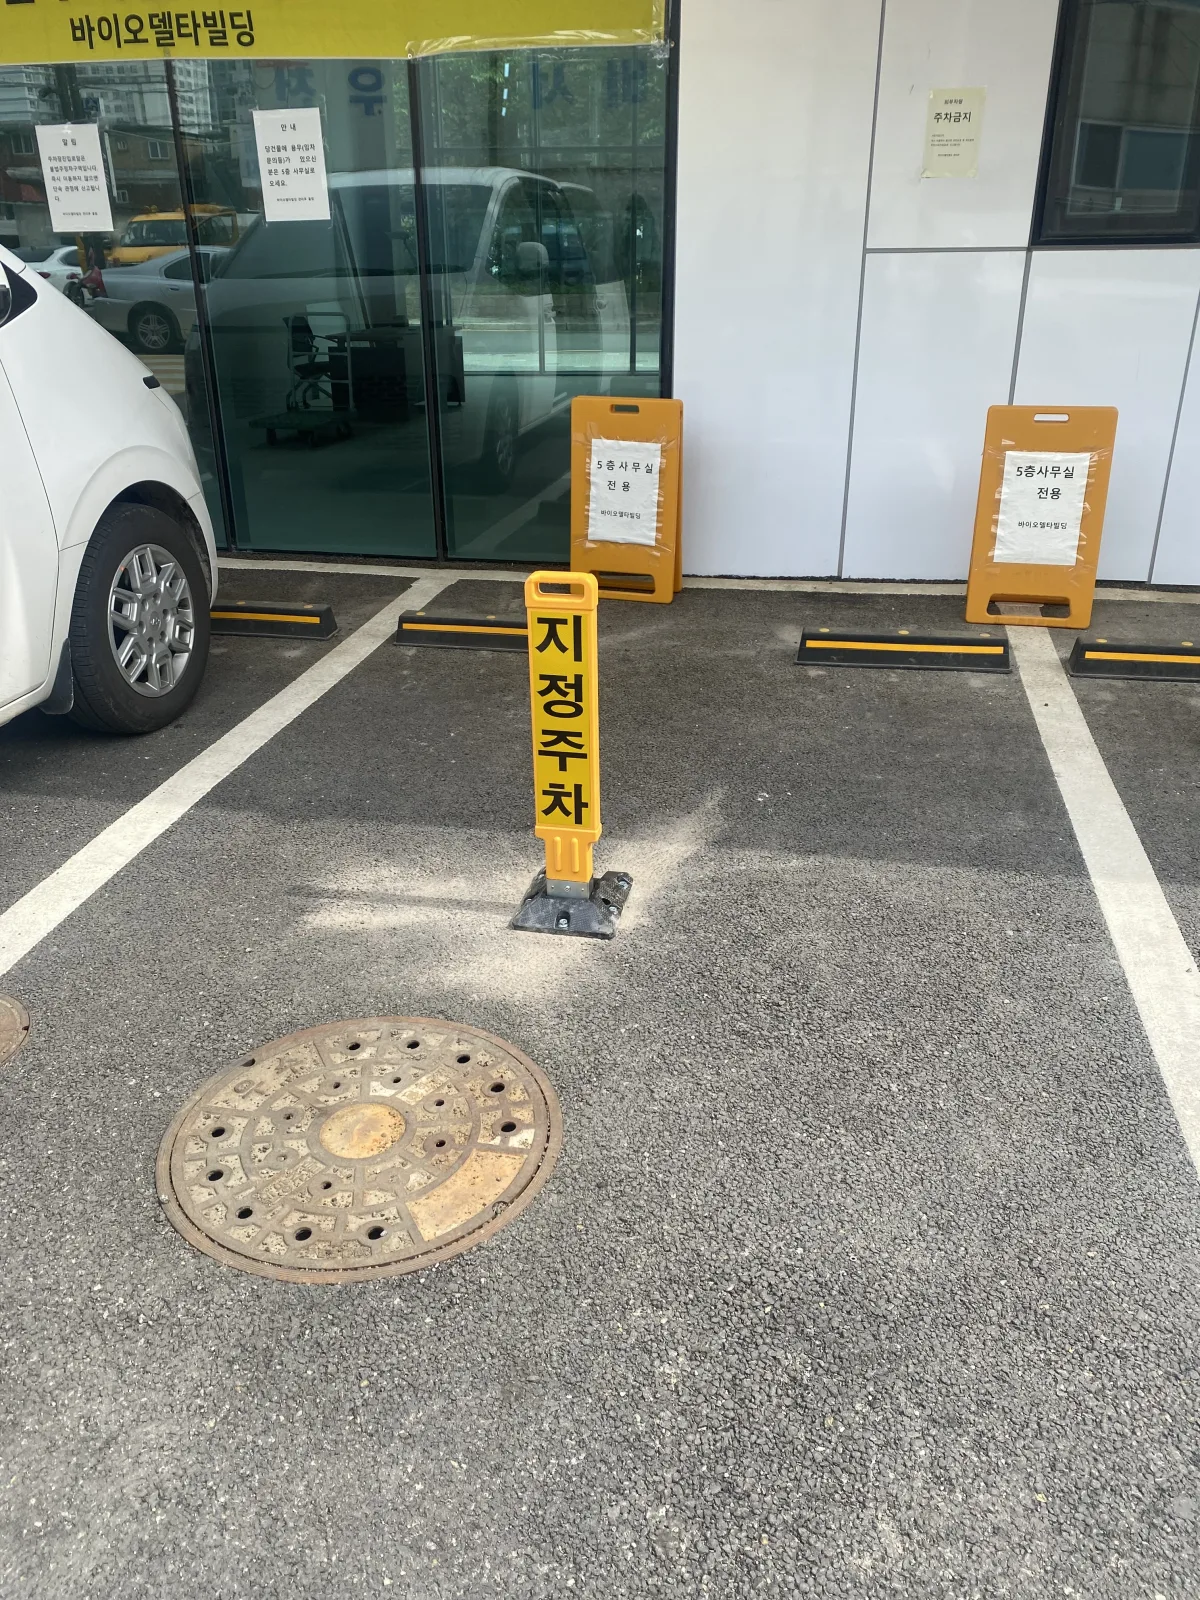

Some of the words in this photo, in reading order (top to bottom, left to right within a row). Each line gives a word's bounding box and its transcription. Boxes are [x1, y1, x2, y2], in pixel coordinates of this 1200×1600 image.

[69, 9, 255, 49] 바이오델타빌딩
[933, 111, 972, 123] 주차금지
[293, 167, 315, 175] 사무실로
[1016, 465, 1075, 479] 5층사무실
[1036, 487, 1062, 500] 전용
[600, 509, 641, 520] 바이오델타빌딩
[1017, 520, 1068, 530] 바이오델타빌딩
[535, 614, 589, 825] 지정주차
